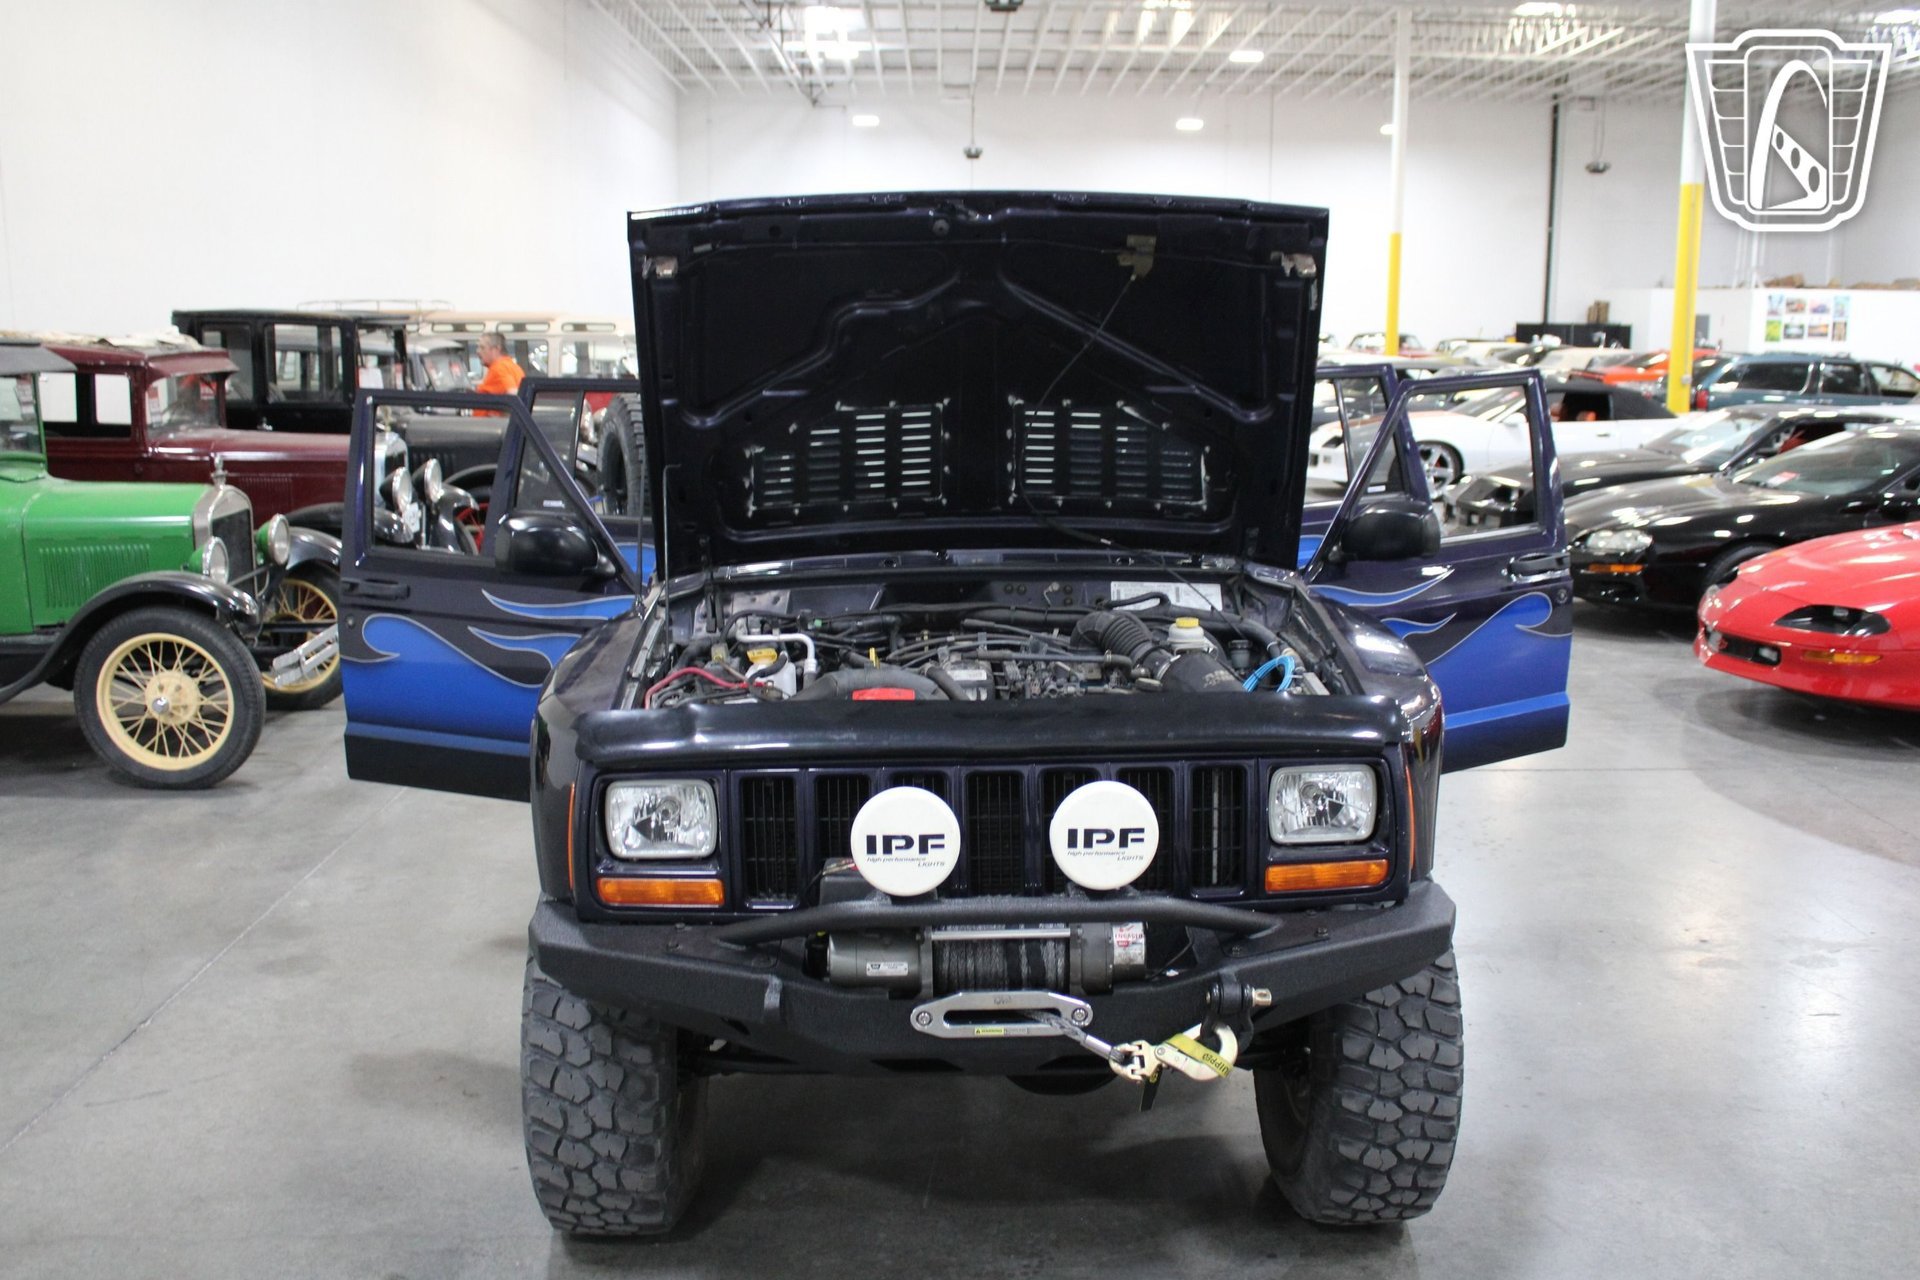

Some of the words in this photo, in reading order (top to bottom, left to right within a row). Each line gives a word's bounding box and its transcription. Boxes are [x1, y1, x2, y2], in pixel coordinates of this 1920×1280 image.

[866, 834, 945, 855] IPF
[1067, 828, 1145, 849] IPF
[1202, 1053, 1230, 1076] UIPPED
